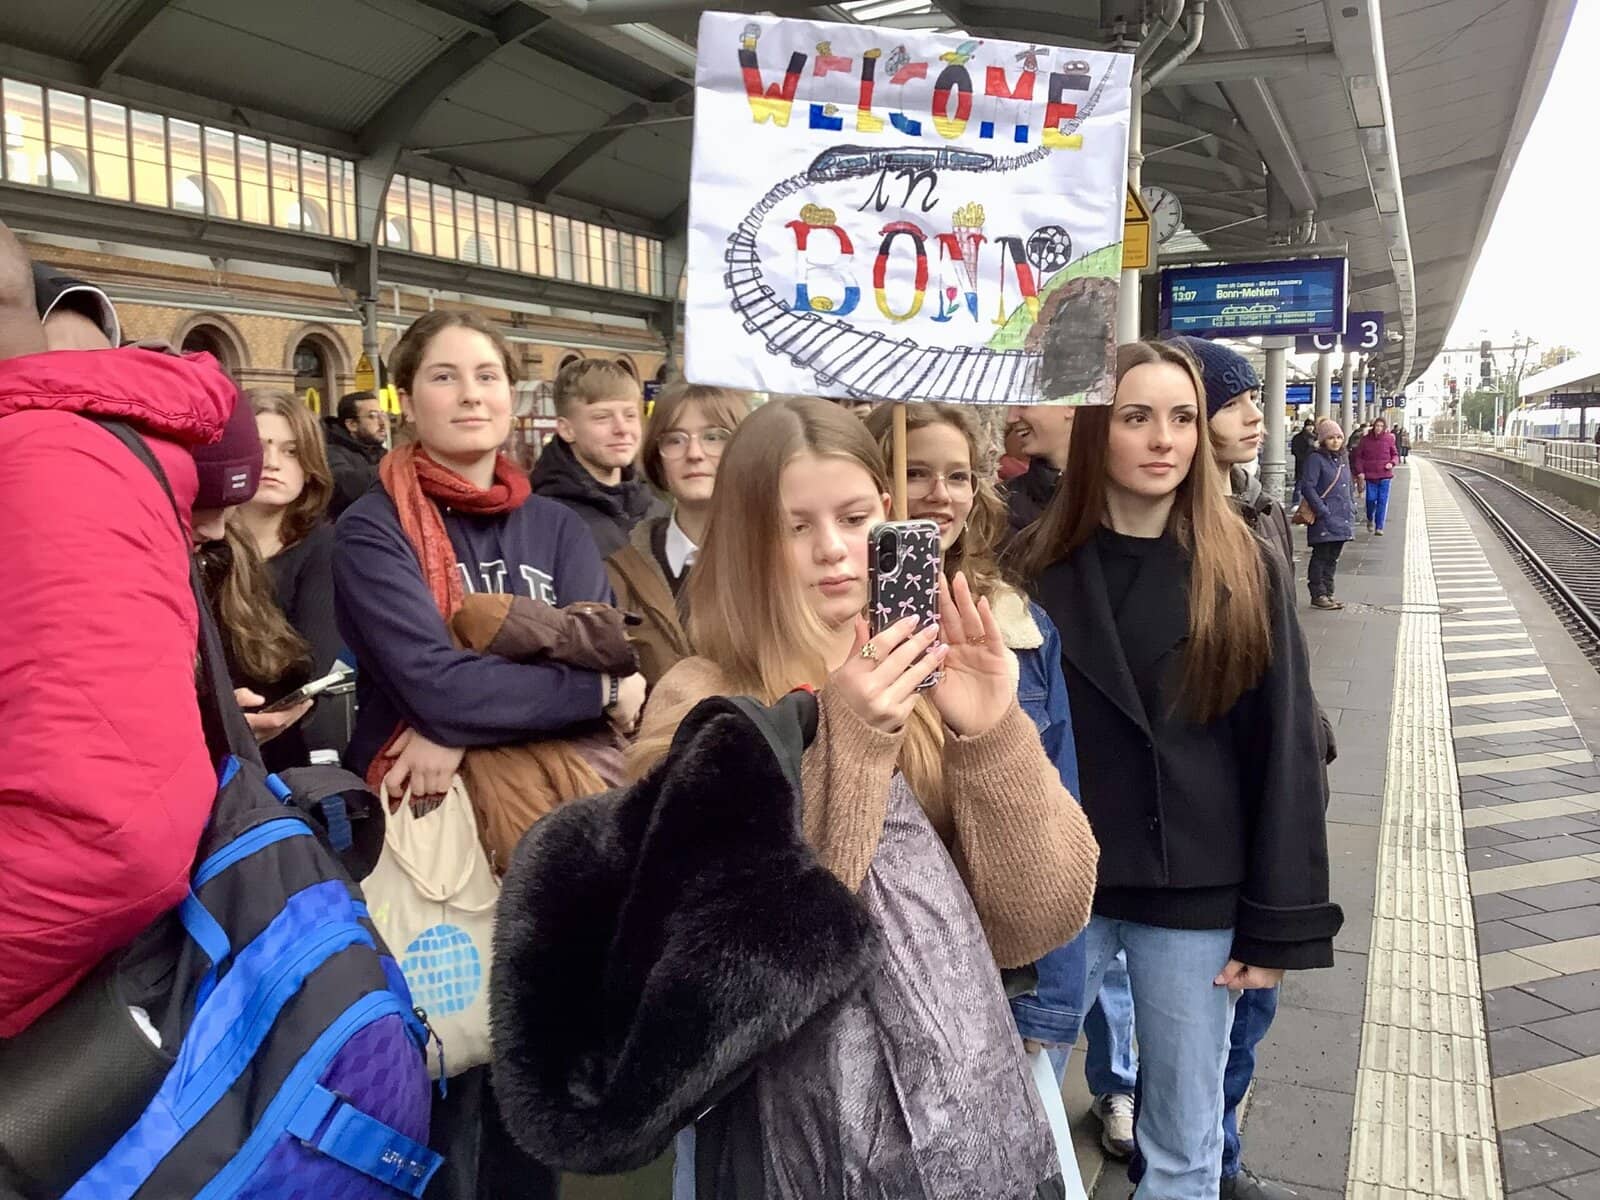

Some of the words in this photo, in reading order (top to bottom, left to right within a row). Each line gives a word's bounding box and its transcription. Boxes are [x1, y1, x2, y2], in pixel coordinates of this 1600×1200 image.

[738, 46, 1092, 150] WELCOME
[857, 153, 940, 213] in
[784, 219, 1051, 325] BONN
[1172, 290, 1197, 302] 13:07
[1216, 287, 1280, 300] Bonn-Mehlem
[1360, 320, 1378, 348] 3
[1386, 398, 1393, 407] B
